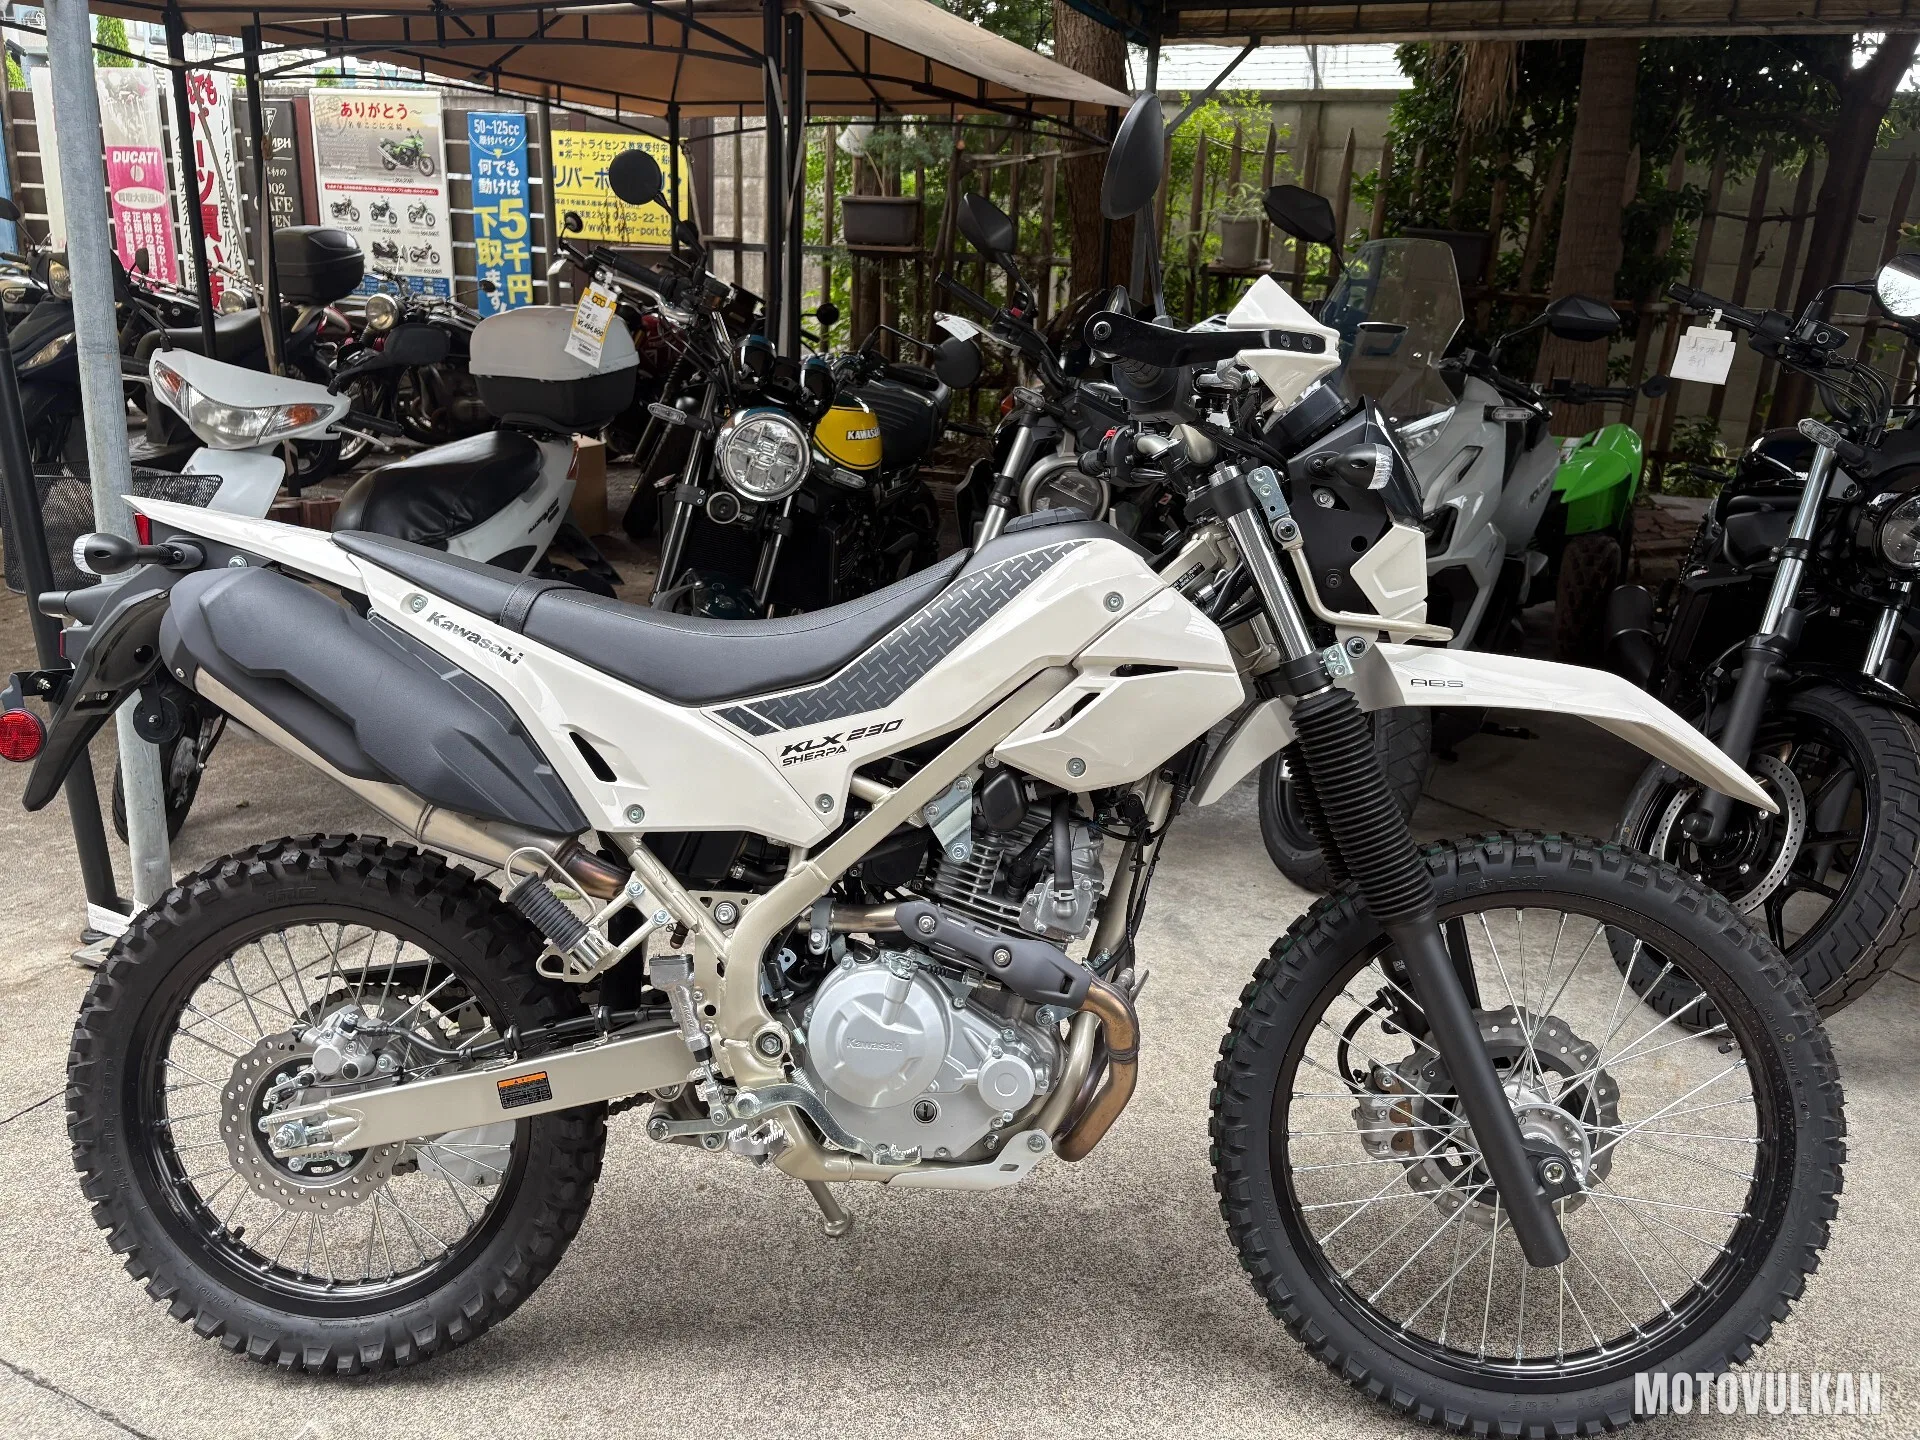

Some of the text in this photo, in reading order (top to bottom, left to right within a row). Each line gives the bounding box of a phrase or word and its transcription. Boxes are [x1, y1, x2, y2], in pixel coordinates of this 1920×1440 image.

[341, 102, 408, 120] ありがとう
[112, 150, 158, 165] DUCATI
[478, 159, 519, 174] 何でも
[478, 178, 521, 196] 動けば
[426, 611, 524, 665] Kawasaki
[1410, 678, 1464, 688] ABS
[780, 719, 904, 757] KLX 230
[782, 744, 847, 767] SHERPA
[846, 1037, 904, 1052] Kawasaki
